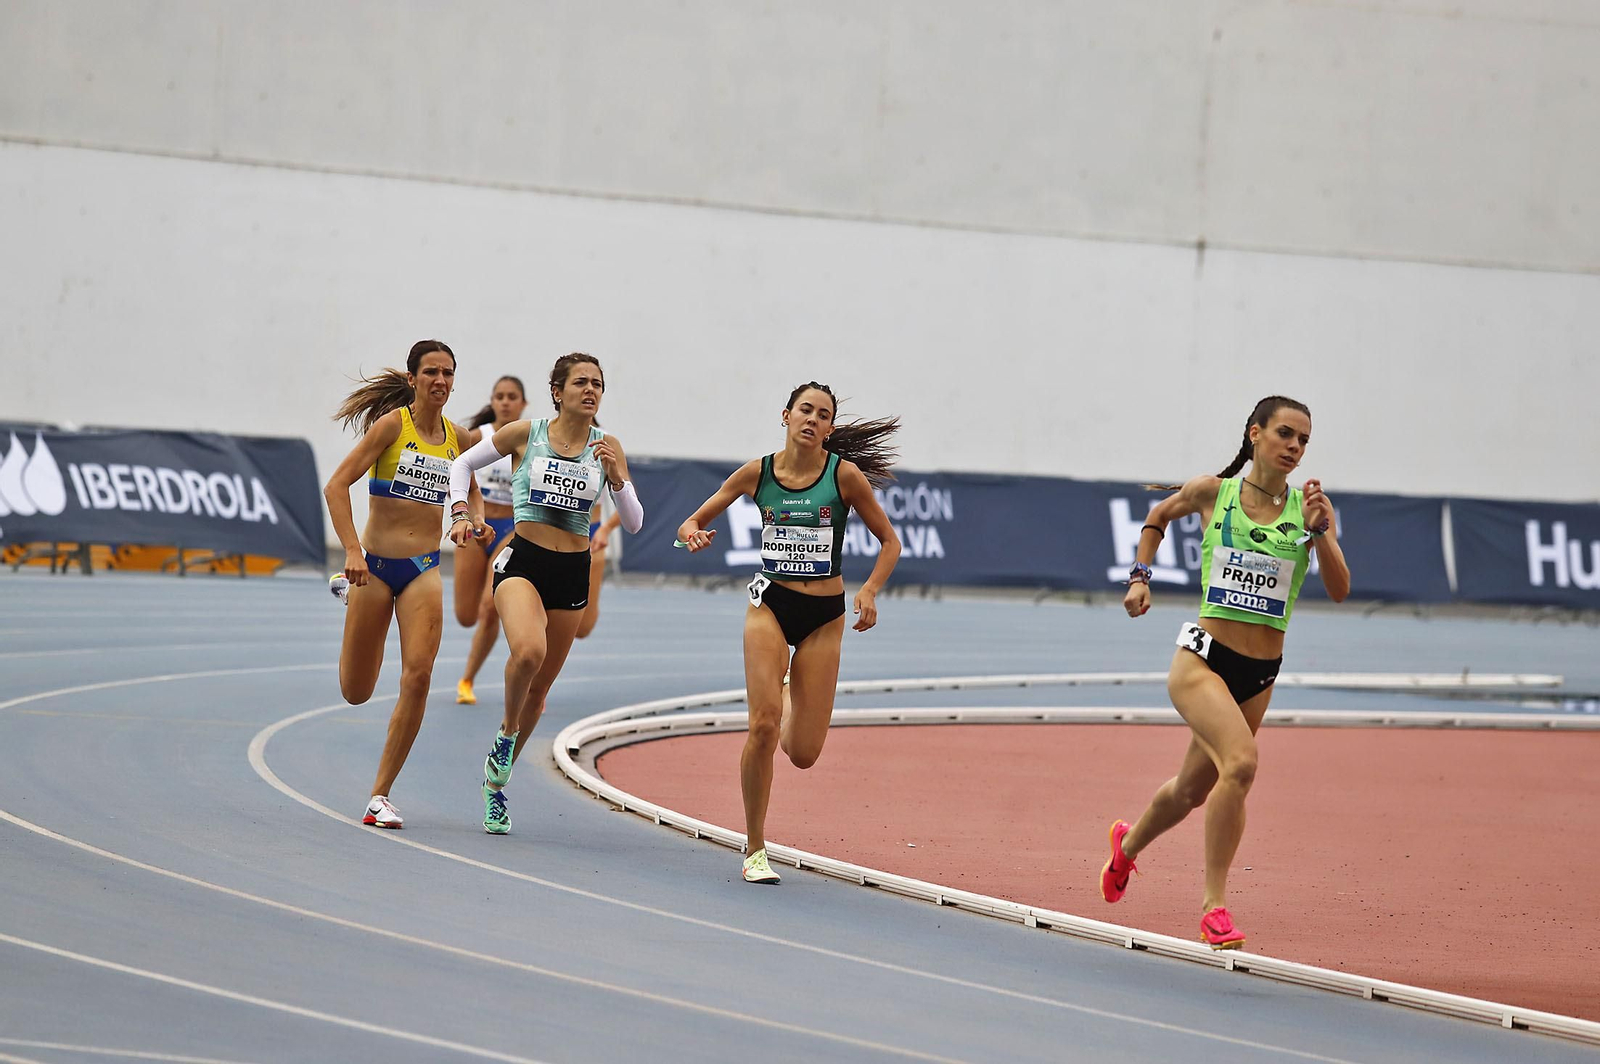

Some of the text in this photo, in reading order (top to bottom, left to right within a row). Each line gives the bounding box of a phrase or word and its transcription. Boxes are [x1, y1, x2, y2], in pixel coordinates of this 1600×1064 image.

[421, 481, 435, 490] 119
[543, 474, 587, 491] RECIO
[68, 463, 278, 524] IBERDROLA
[557, 487, 574, 496] 118
[763, 542, 830, 553] RODRIGUEZ
[841, 523, 945, 559] HULVA
[787, 553, 806, 561] 120
[1525, 519, 1600, 590] Hu
[1222, 567, 1277, 589] PRADO
[1240, 584, 1261, 594] 117
[1183, 627, 1206, 653] 3
